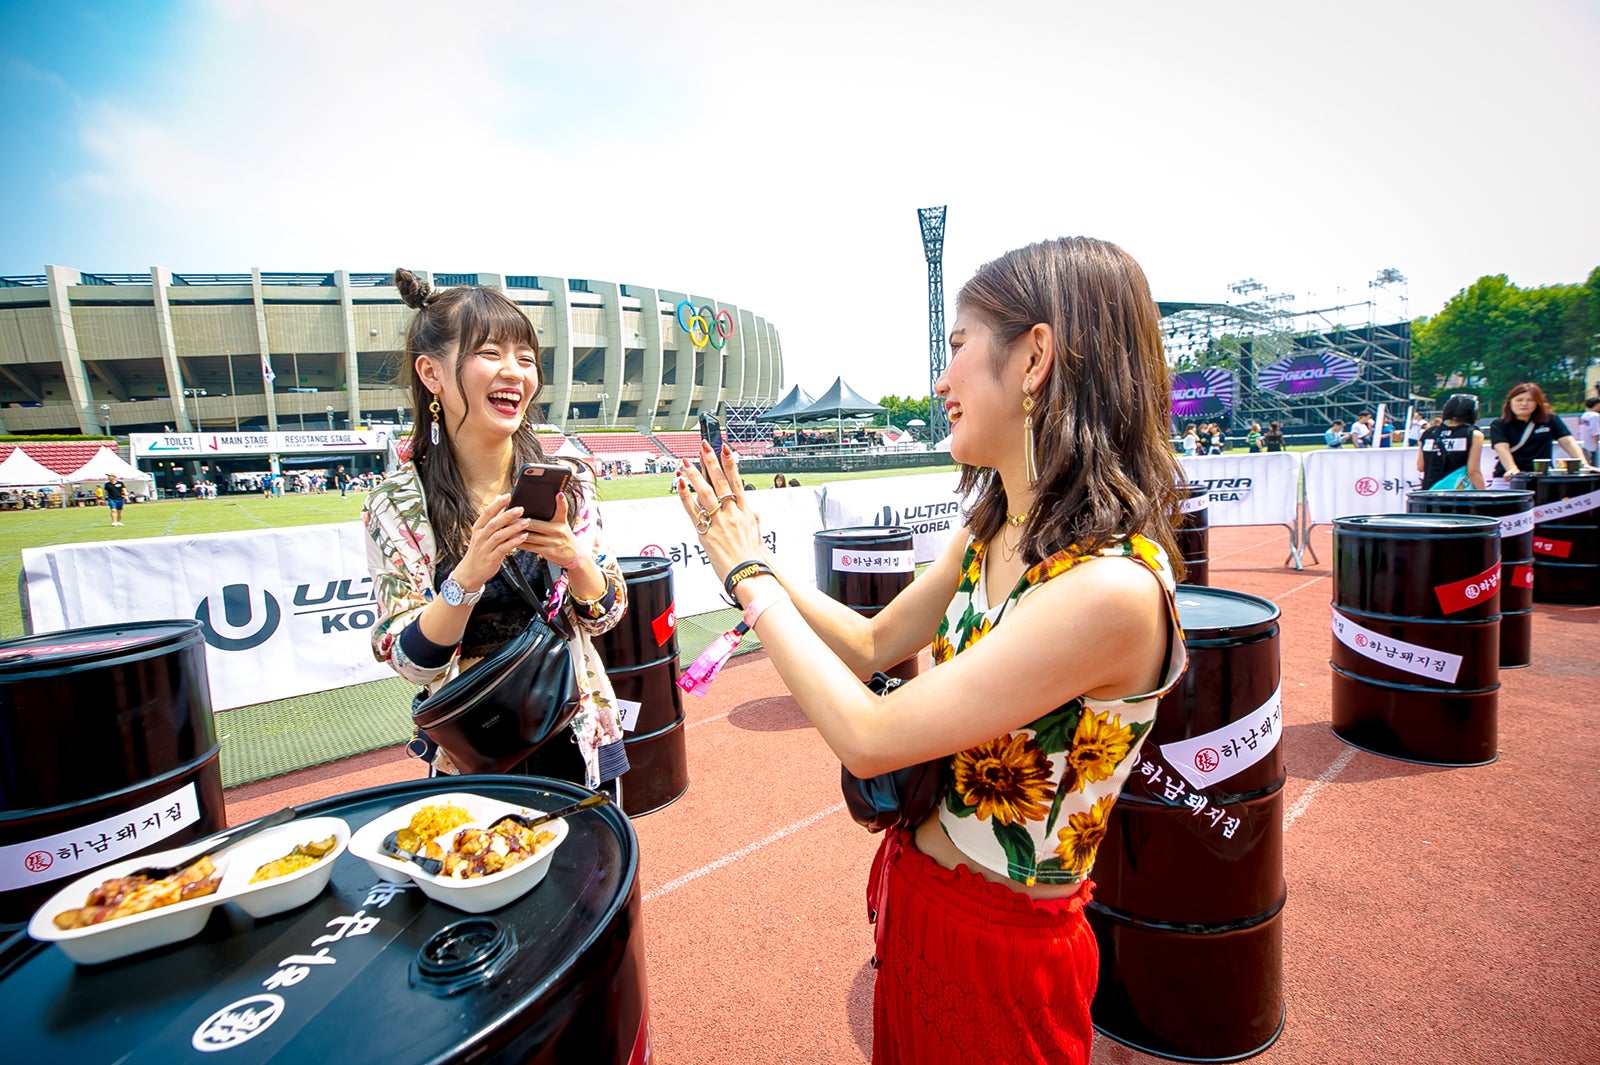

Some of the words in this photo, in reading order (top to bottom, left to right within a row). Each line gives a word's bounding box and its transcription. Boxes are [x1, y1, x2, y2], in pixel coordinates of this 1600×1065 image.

[164, 437, 193, 446] TOILET
[221, 436, 242, 445] MAIN
[245, 435, 269, 444] STAGE
[285, 435, 328, 443] RESISTANCE
[331, 434, 352, 443] STAGE
[1190, 478, 1252, 490] TRA
[1209, 493, 1240, 501] REA
[904, 502, 958, 520] ULTRA
[911, 521, 950, 534] KOREA
[322, 610, 377, 634] KO
[1369, 641, 1446, 672] 하남돼지집
[1140, 761, 1241, 839] 하남돼지집
[56, 802, 182, 861] 하남돼지집
